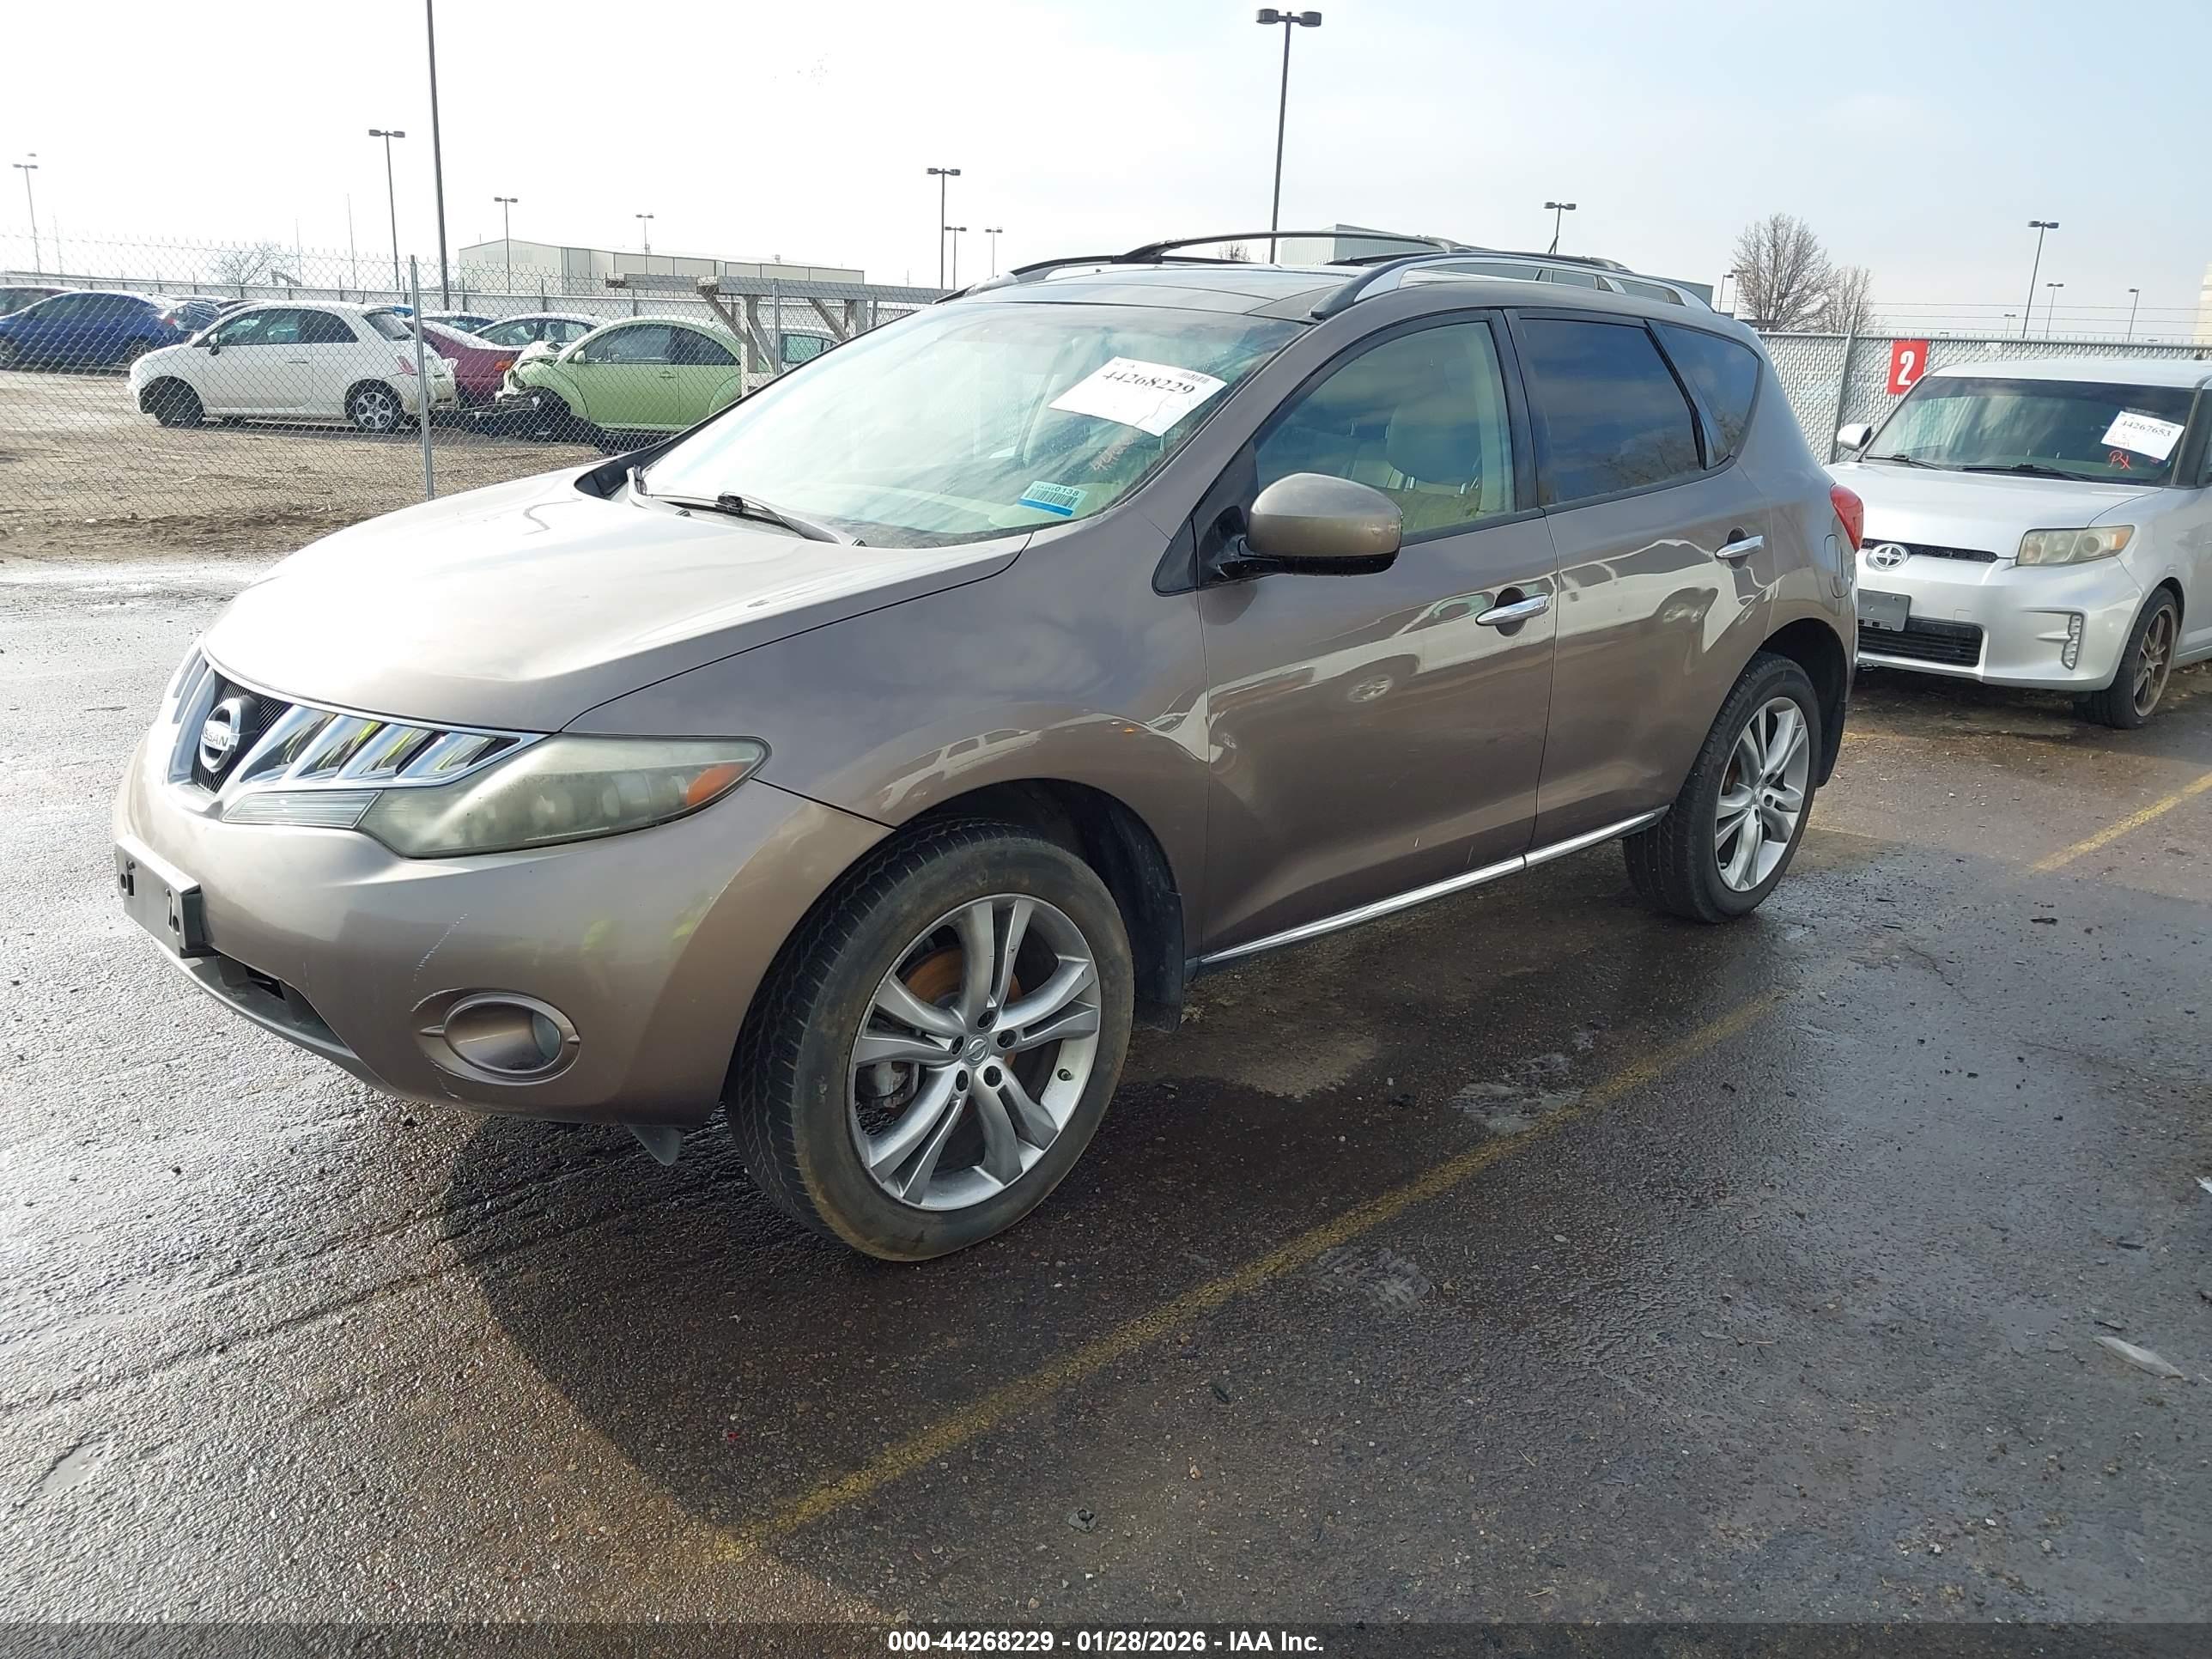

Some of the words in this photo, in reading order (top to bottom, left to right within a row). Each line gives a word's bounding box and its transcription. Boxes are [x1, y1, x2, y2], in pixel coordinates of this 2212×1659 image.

[1897, 350, 1916, 386] 2
[1102, 371, 1196, 394] 44268229
[202, 727, 229, 747] SSAN
